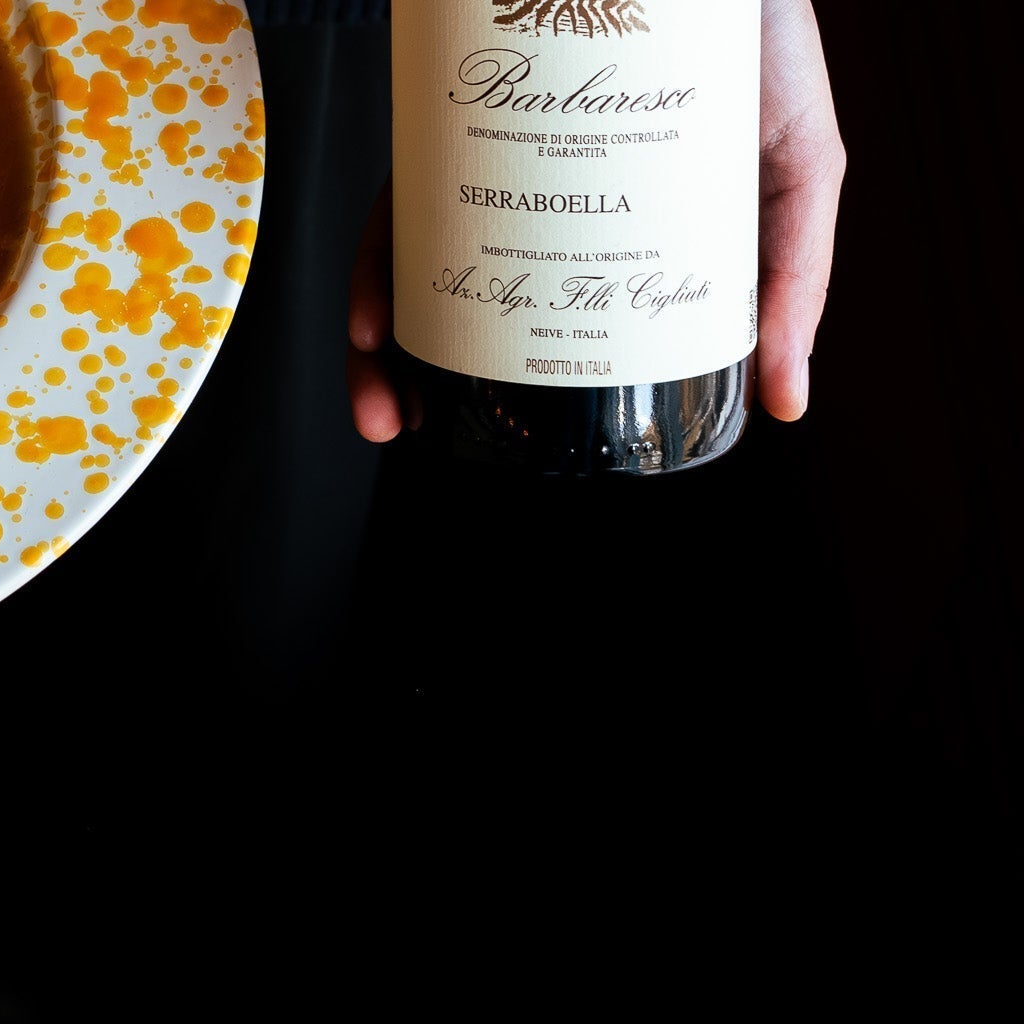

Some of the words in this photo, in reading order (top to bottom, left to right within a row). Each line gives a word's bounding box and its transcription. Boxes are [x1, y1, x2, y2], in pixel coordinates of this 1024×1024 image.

[449, 48, 697, 115] Barbaresco
[467, 126, 547, 144] DENOMINAZIONE
[550, 133, 561, 144] DI
[564, 134, 608, 145] ORIGINE
[610, 130, 680, 145] CONTROLLATA
[538, 146, 544, 157] E
[547, 147, 607, 158] GARANTITA
[459, 184, 632, 214] SERRABOELLA
[481, 245, 567, 262] IMBOTTIGLIATO
[570, 251, 643, 262] ALL'ORIGINE
[645, 250, 660, 260] DA
[477, 273, 538, 317] Agr.
[549, 276, 620, 311] F.lli
[530, 327, 563, 339] NEIVE
[573, 330, 609, 339] ITALIA
[525, 358, 571, 376] PRODOTTO
[574, 360, 583, 376] IN
[585, 360, 612, 376] ITALIA
